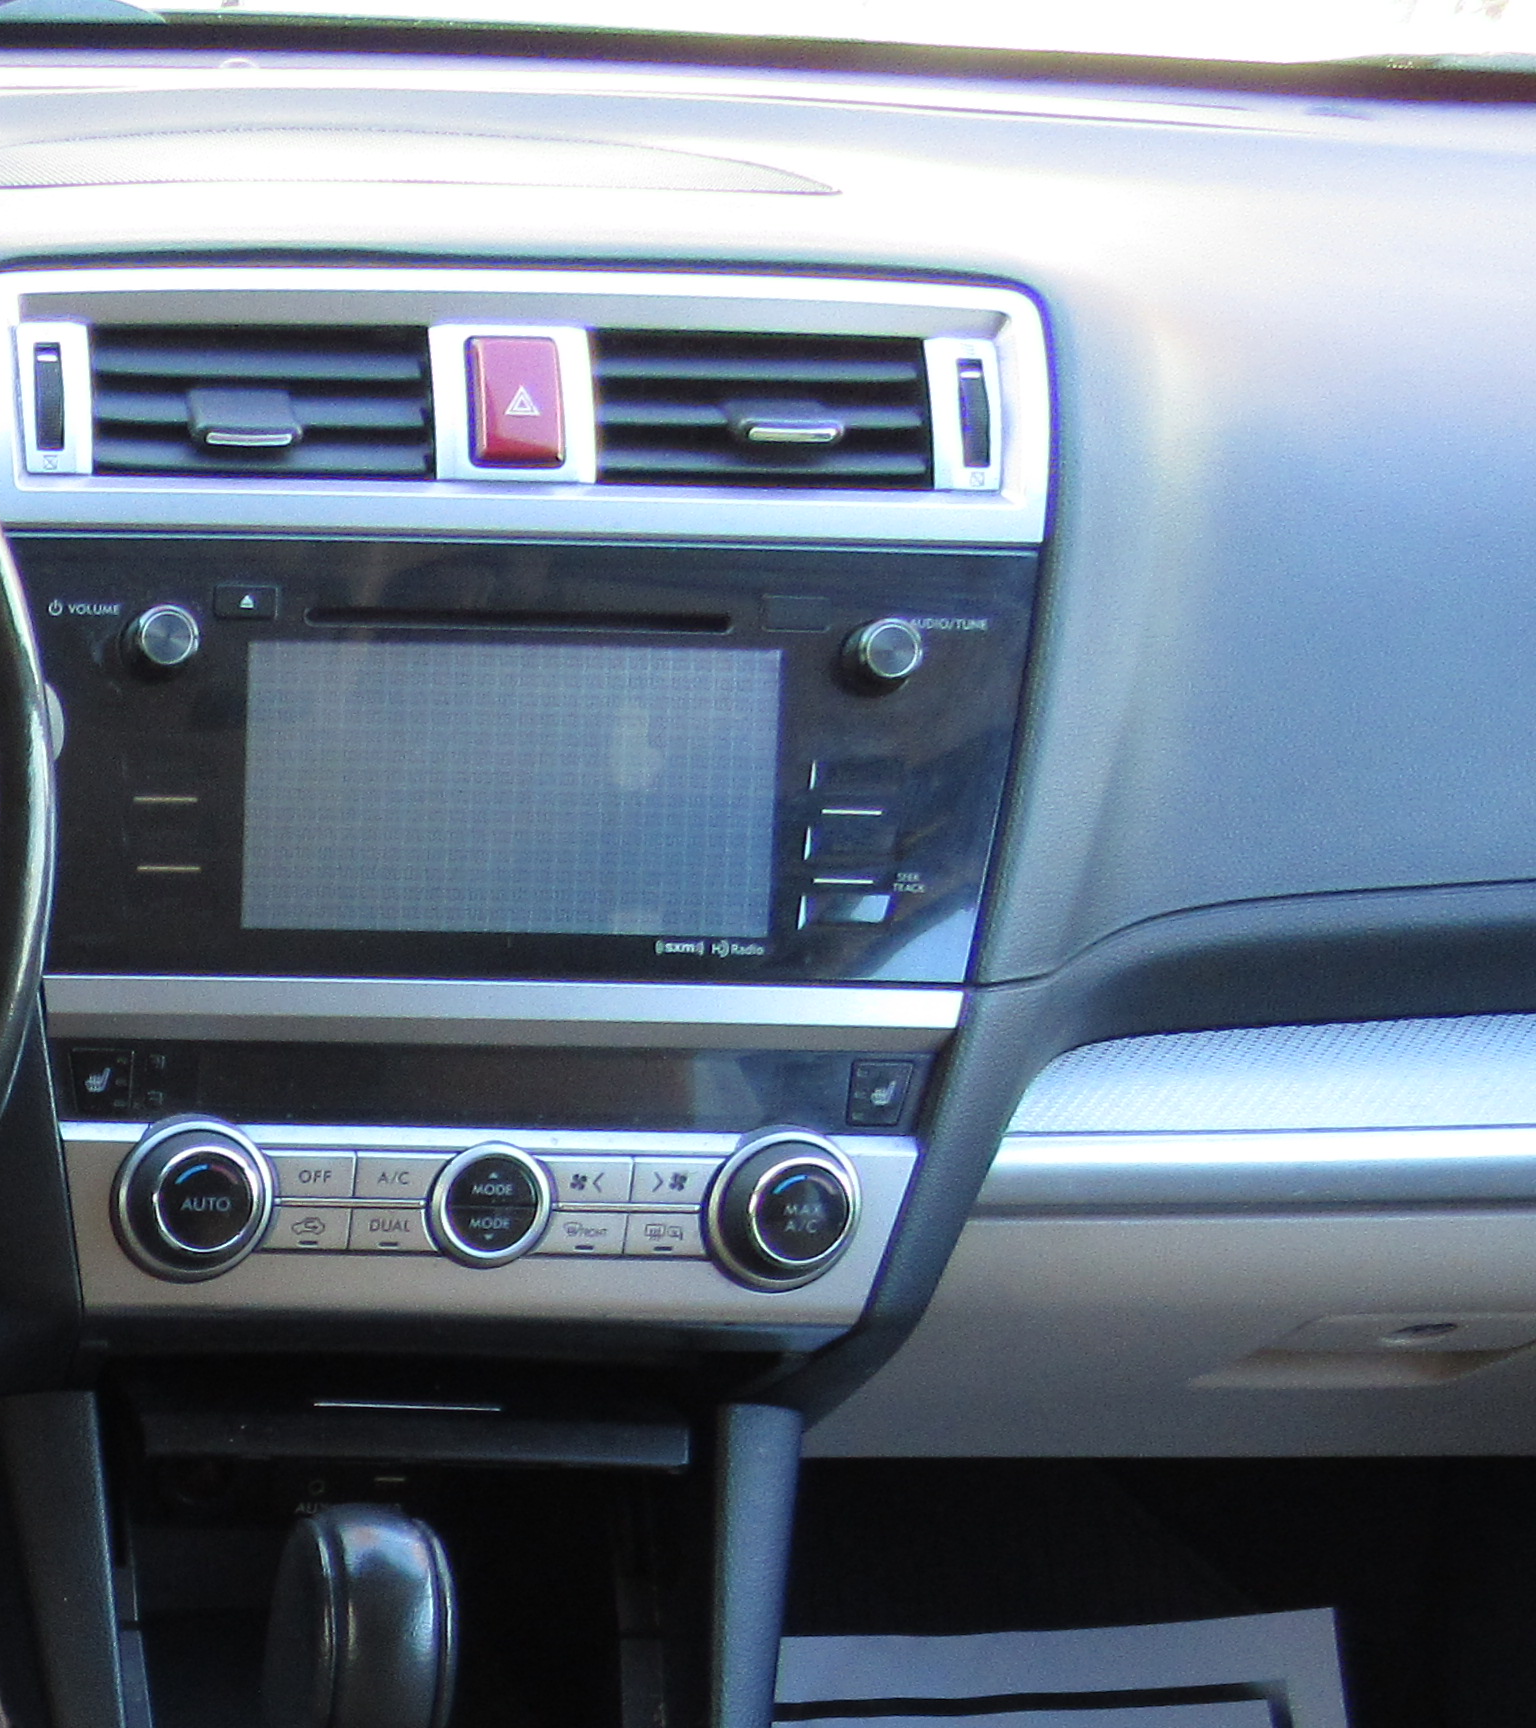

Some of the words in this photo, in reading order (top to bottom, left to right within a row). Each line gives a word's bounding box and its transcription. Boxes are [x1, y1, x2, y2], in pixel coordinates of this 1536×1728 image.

[67, 603, 121, 616] VOLUME
[894, 882, 924, 893] TRACK
[730, 943, 764, 955] Radio
[298, 1169, 332, 1184] OFF
[377, 1171, 410, 1186] A/C
[471, 1184, 514, 1197] MODE
[180, 1197, 232, 1213] AUTO
[783, 1203, 823, 1215] MAX
[369, 1218, 411, 1233] DUAL
[469, 1217, 510, 1230] MODE
[784, 1219, 818, 1234] A/C
